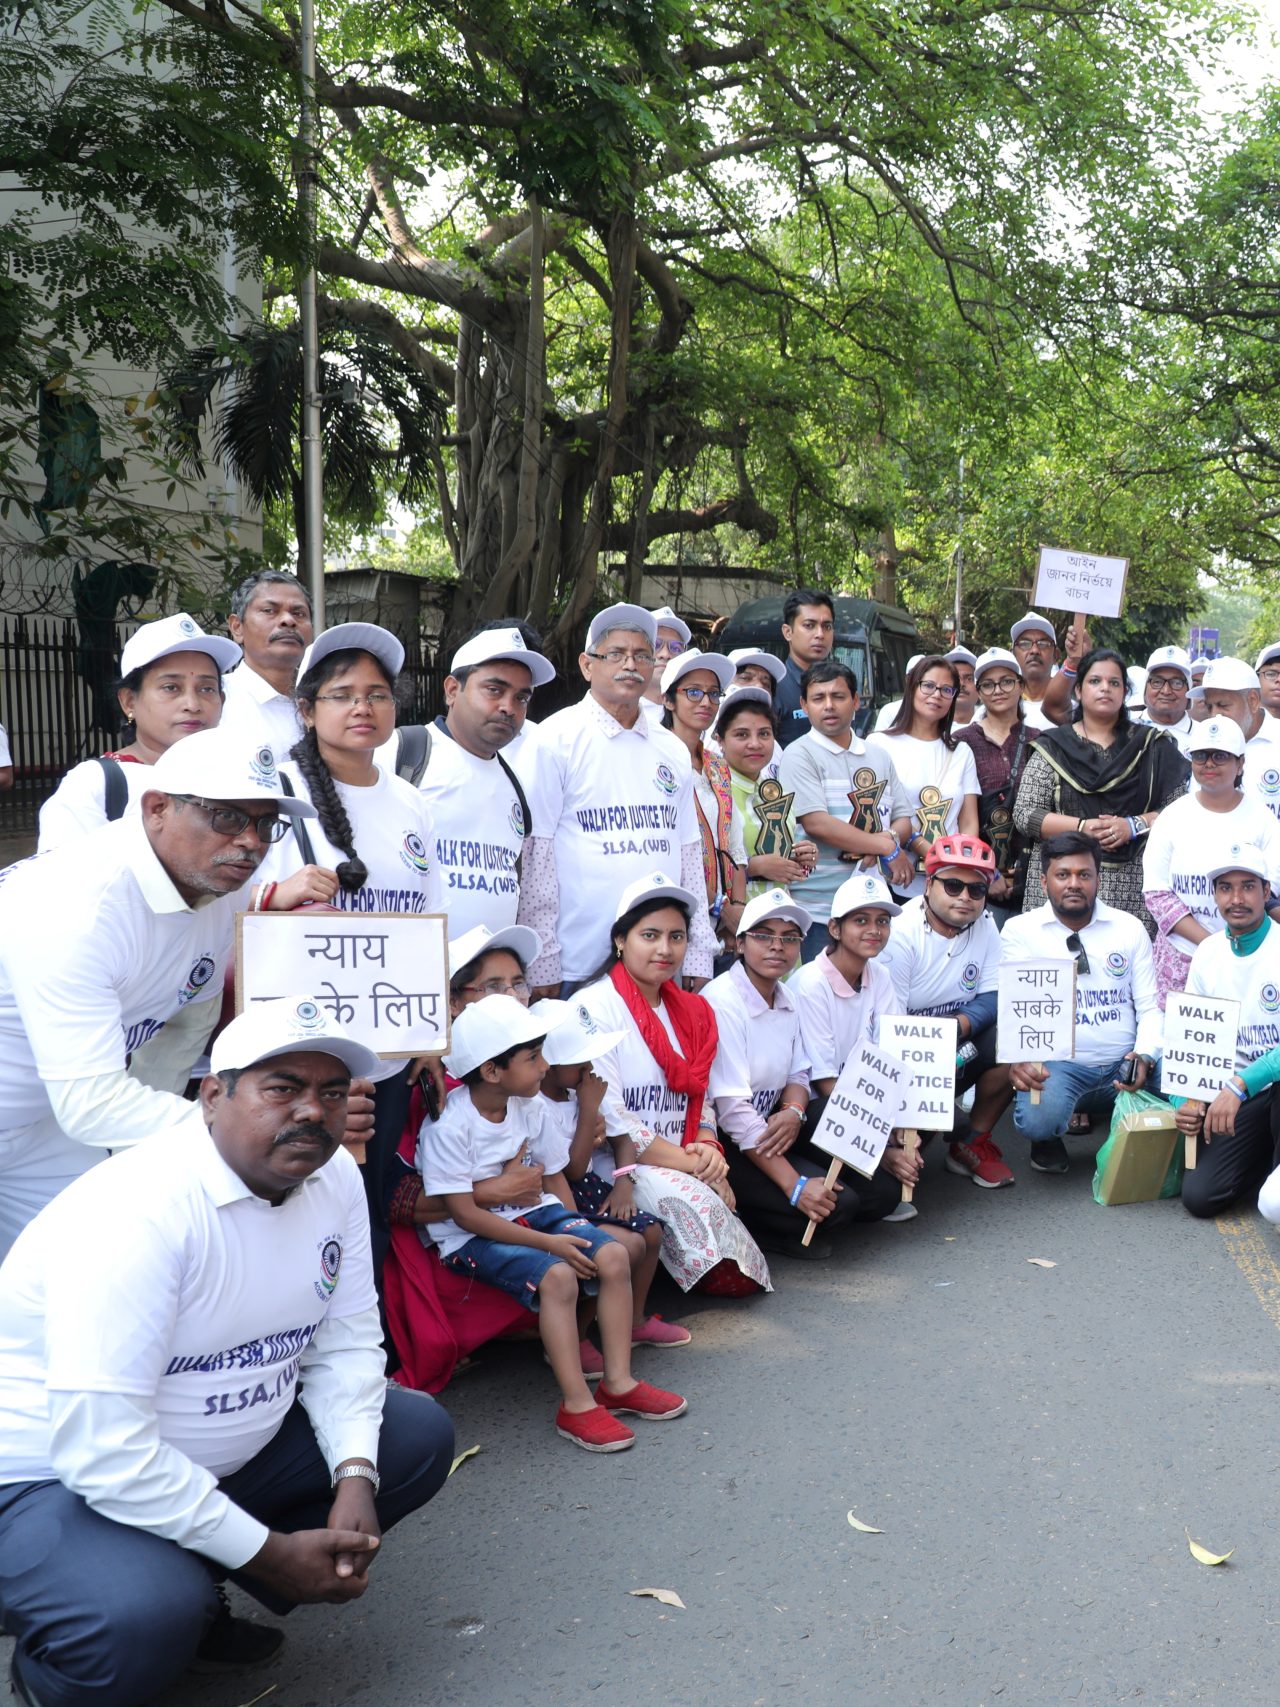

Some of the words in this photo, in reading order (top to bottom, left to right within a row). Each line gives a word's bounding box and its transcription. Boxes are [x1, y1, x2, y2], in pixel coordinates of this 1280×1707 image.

[577, 808, 608, 832] WALK
[607, 805, 629, 831] FOR
[628, 805, 660, 832] JUSTICE
[436, 839, 458, 866] ALK
[460, 840, 482, 868] FOR
[1191, 875, 1206, 895] FOR
[304, 934, 389, 969] न्याय
[1017, 969, 1060, 987] न्याय
[369, 981, 440, 1032] लिए
[1011, 994, 1064, 1018] सबके
[1179, 1005, 1225, 1023] WALK
[894, 1024, 943, 1039] WALK
[1018, 1025, 1055, 1051] लिए
[1184, 1029, 1216, 1044] FOR
[861, 1049, 901, 1083] WALK
[901, 1050, 935, 1063] FOR
[1165, 1049, 1233, 1069] JUSTICE
[856, 1077, 885, 1103] FOR
[1167, 1071, 1188, 1085] TO
[830, 1094, 890, 1136] JUSTICE
[918, 1101, 949, 1114] ALL
[825, 1118, 845, 1138] TO
[850, 1135, 876, 1158] ALL
